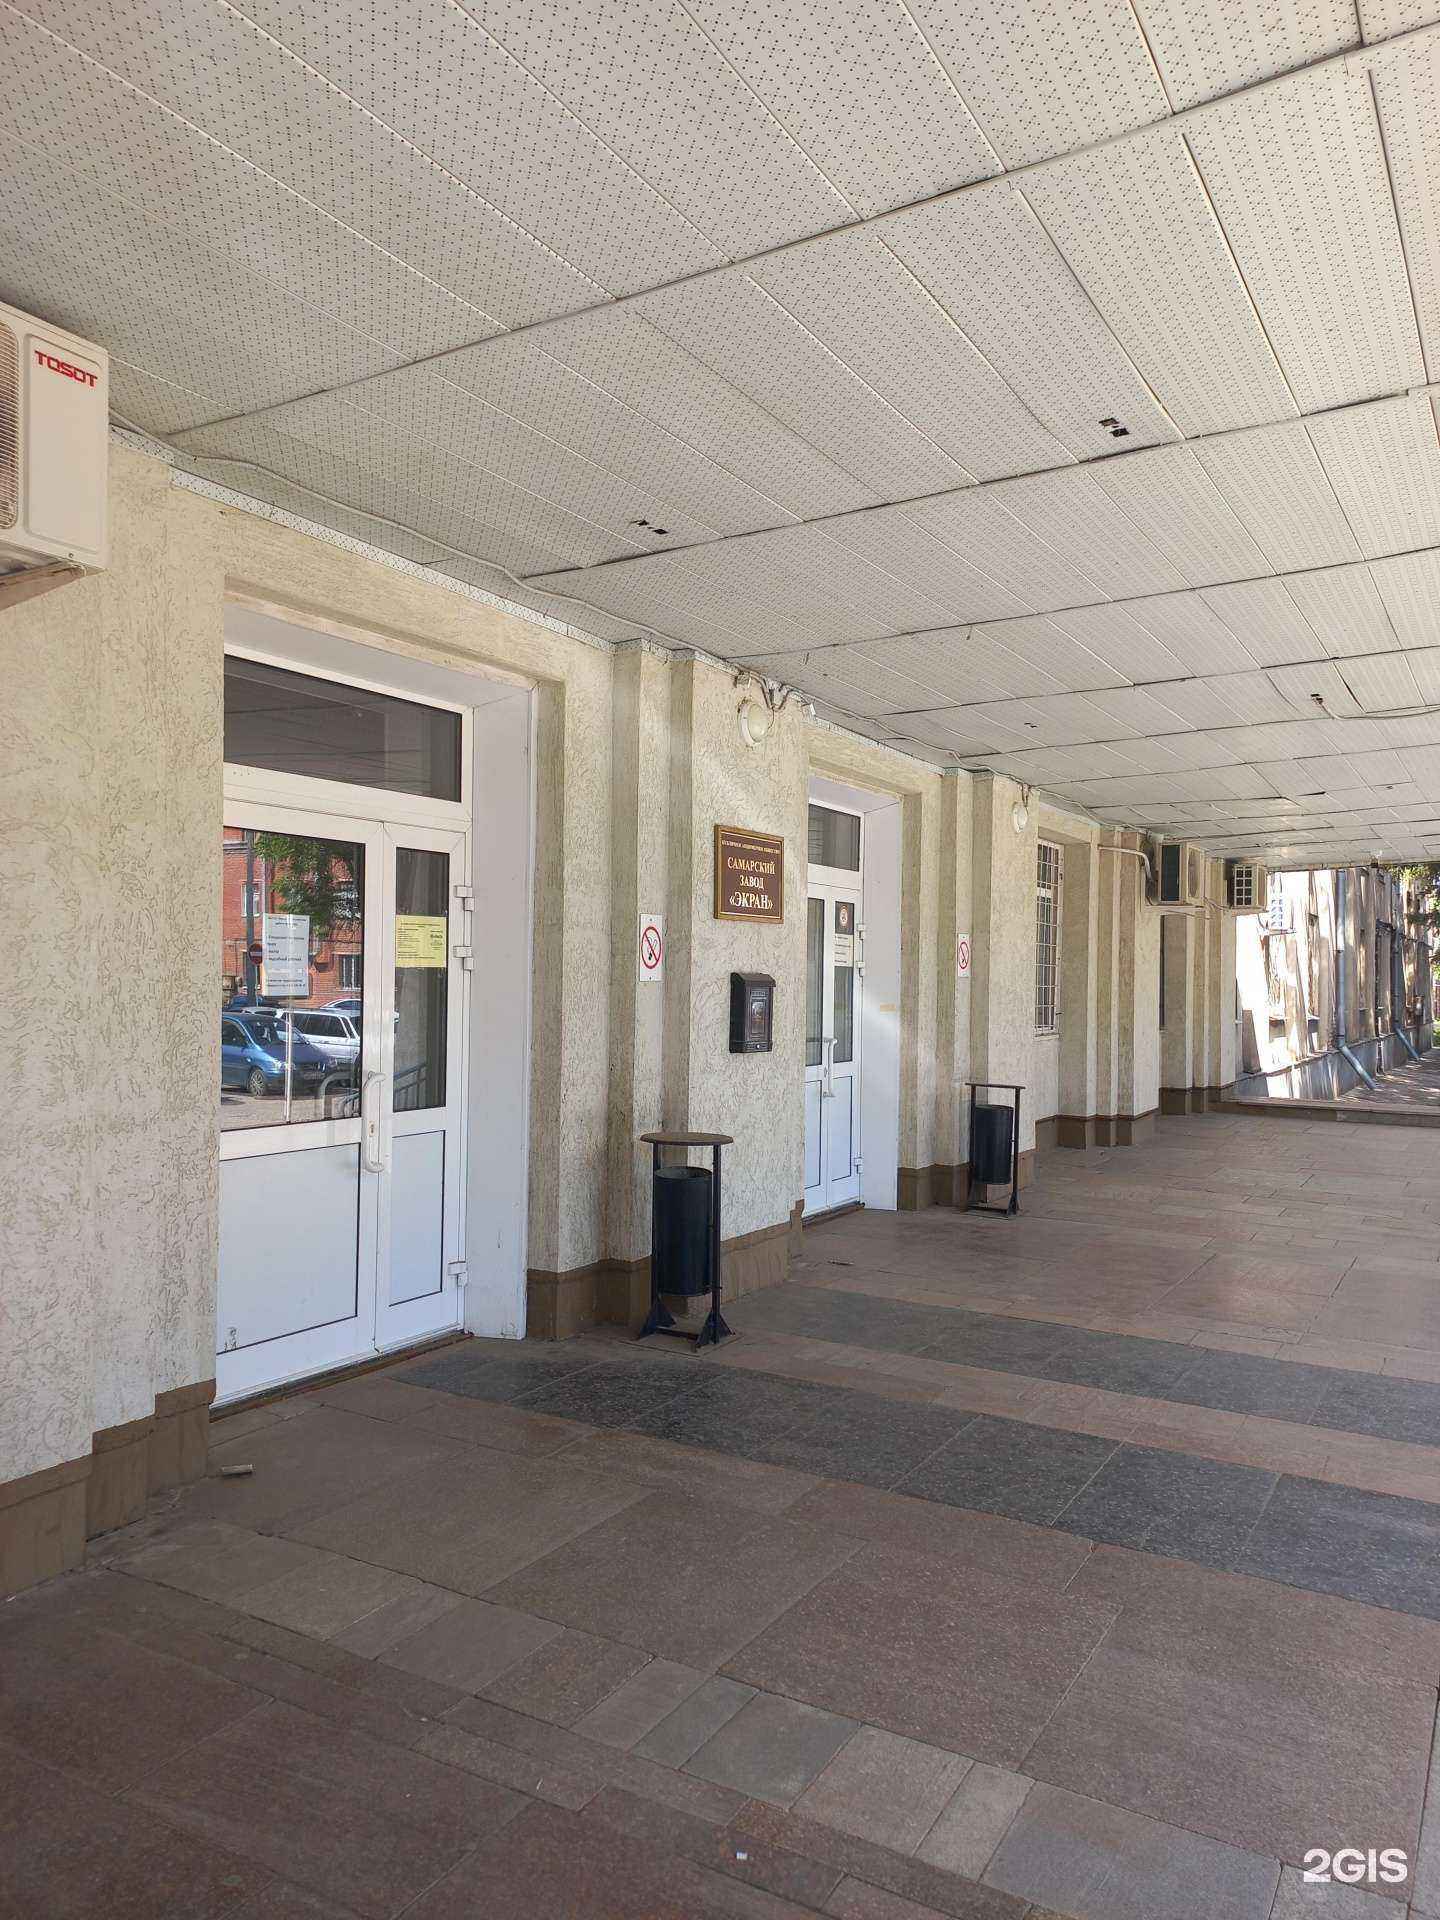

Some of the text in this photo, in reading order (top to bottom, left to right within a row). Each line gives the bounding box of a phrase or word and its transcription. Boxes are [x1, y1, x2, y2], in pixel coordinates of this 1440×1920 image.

[34, 350, 98, 387] TOSOT
[727, 856, 776, 875] САМАРСКИЙ
[739, 874, 765, 890] ЗАВОД
[729, 891, 773, 910] «ЭКРАН»
